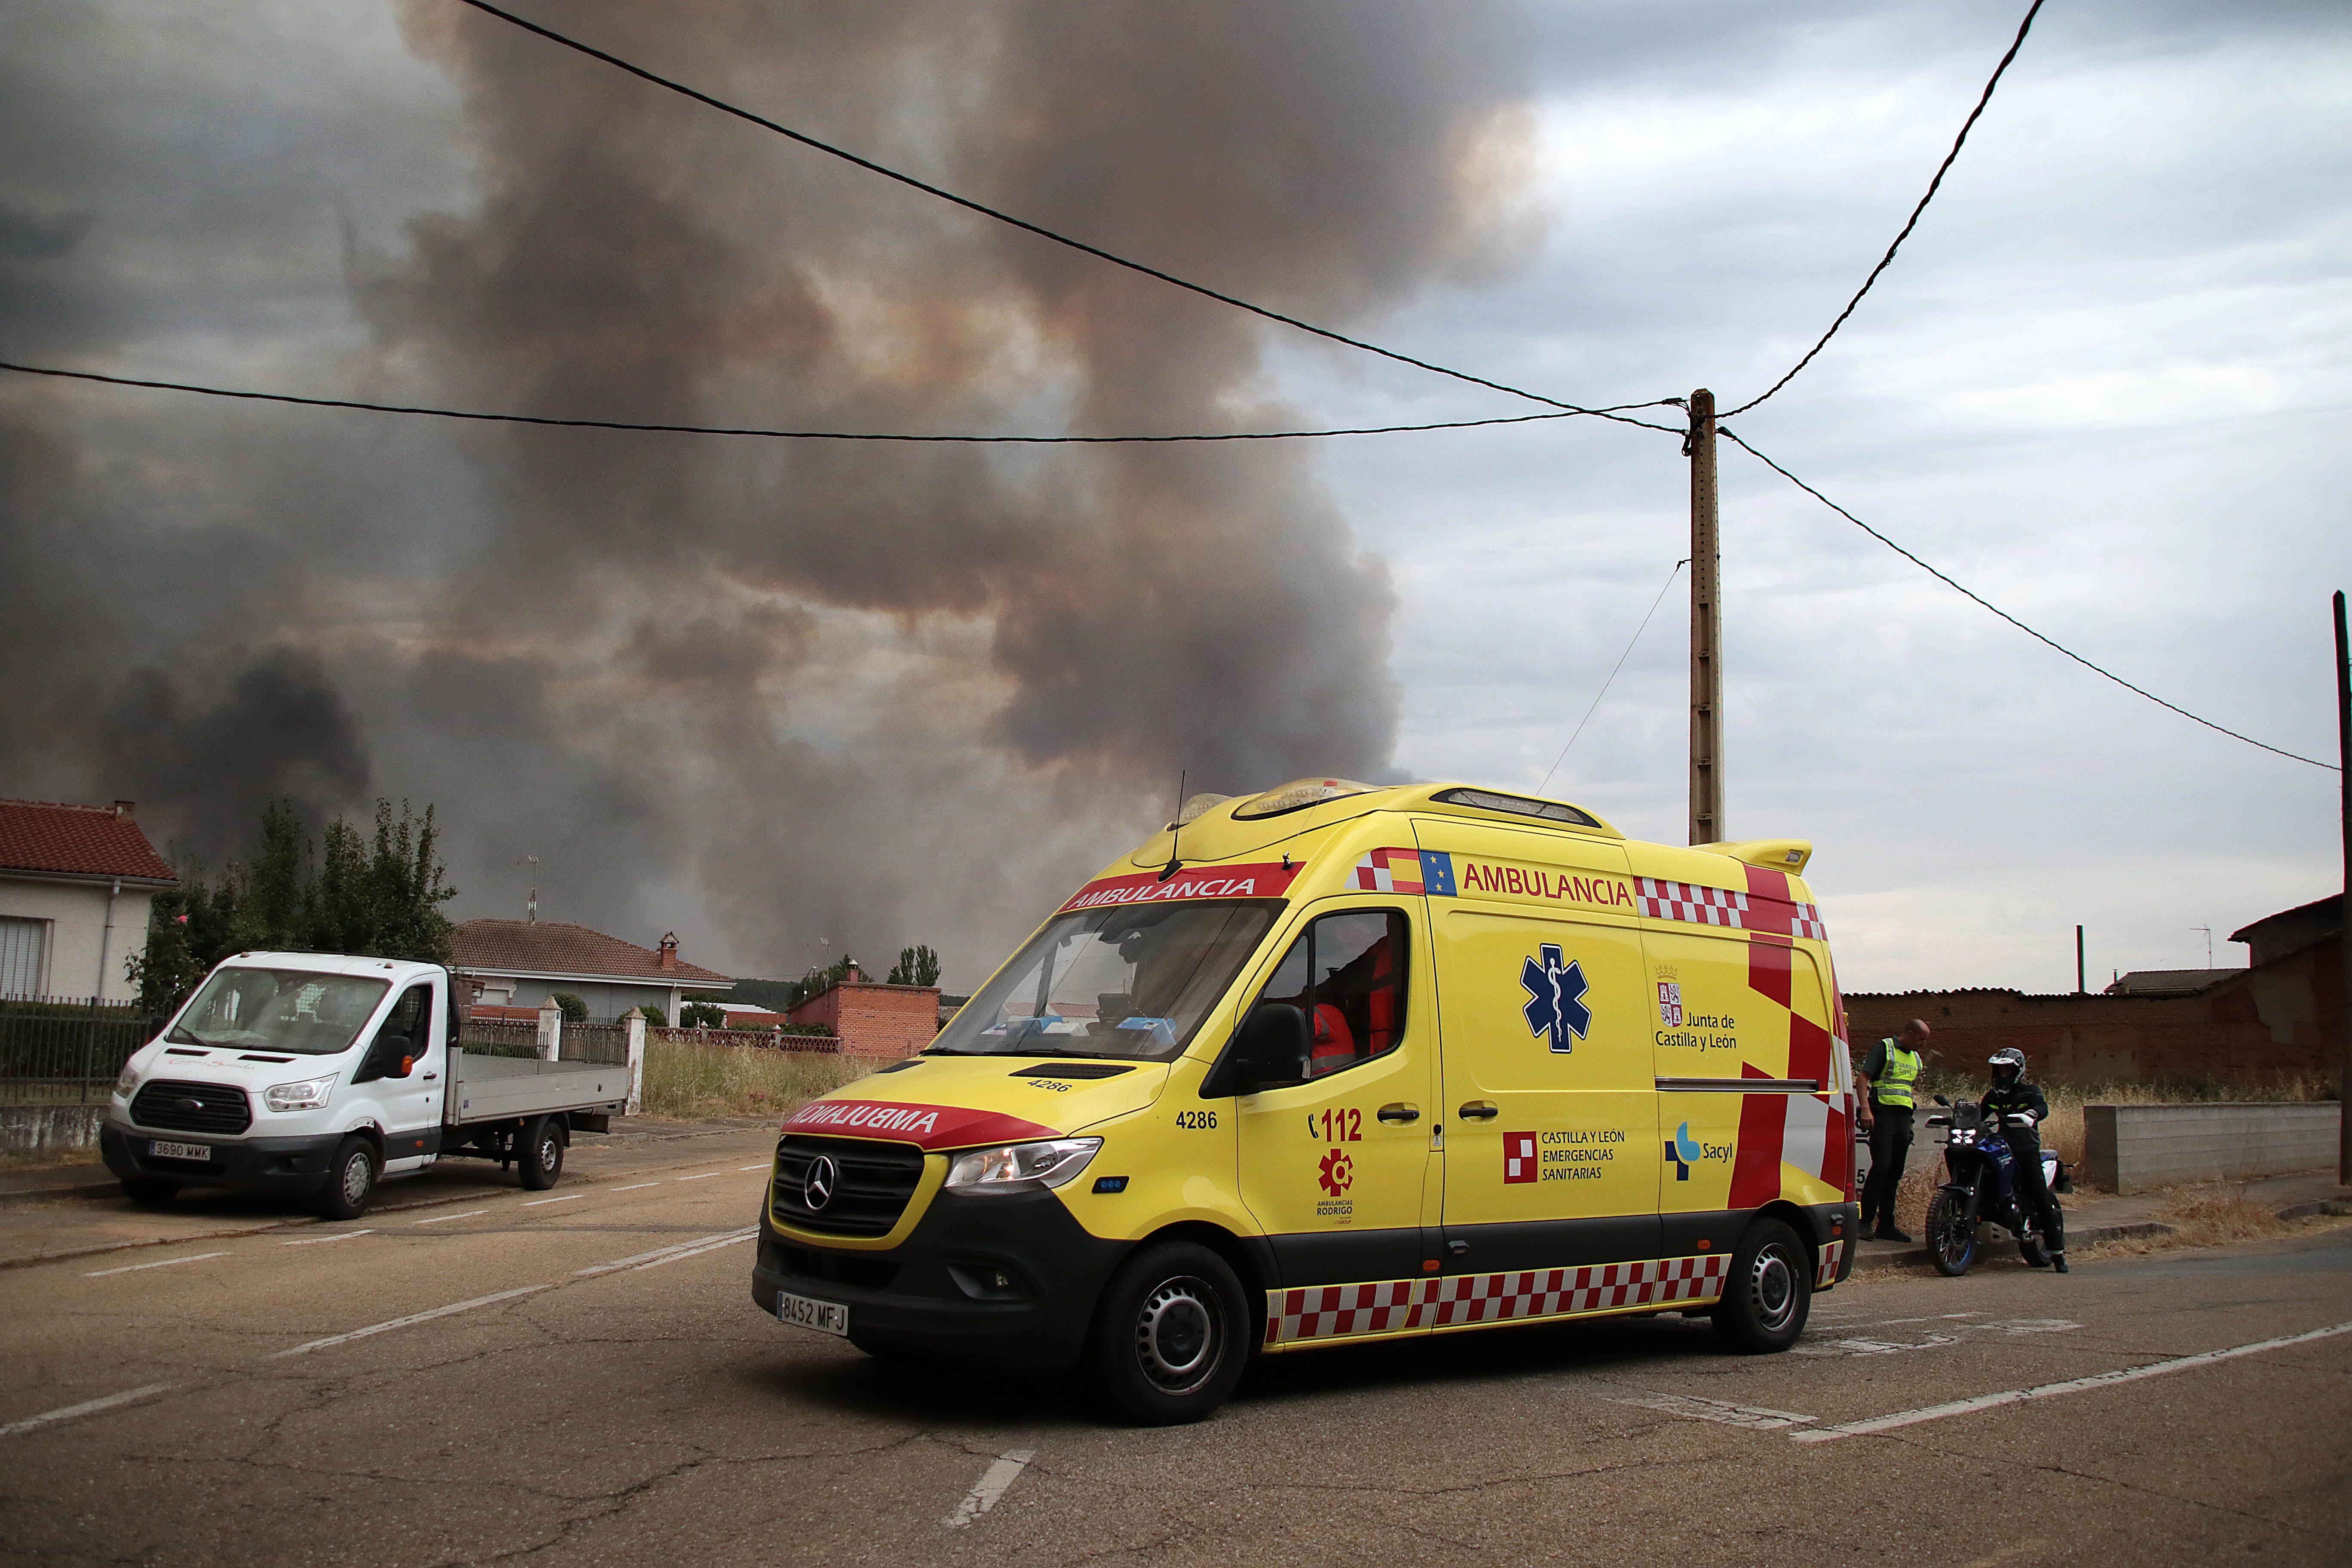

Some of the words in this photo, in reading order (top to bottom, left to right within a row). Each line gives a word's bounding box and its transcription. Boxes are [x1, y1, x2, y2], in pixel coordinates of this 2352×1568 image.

[1070, 878, 1256, 909] AMBULANCIA
[1464, 863, 1633, 907] AMBULANCIA
[1687, 1012, 1718, 1028] Junta
[1721, 1014, 1734, 1029] de
[1655, 1031, 1697, 1047] Castilla
[1700, 1036, 1706, 1052] y
[1710, 1034, 1736, 1048] León
[1028, 1079, 1073, 1092] 4286
[1176, 1111, 1217, 1129] 4286
[1322, 1108, 1362, 1142] 112
[1542, 1131, 1588, 1144] CASTILLA
[1591, 1132, 1597, 1143] Y
[1599, 1128, 1624, 1142] LEÓN
[157, 1143, 183, 1156] 3690
[187, 1146, 208, 1158] MMK
[1543, 1149, 1614, 1162] EMERGENCIAS
[1703, 1143, 1732, 1162] Sacyl
[1542, 1167, 1602, 1181] SANITARIAS
[1317, 1206, 1352, 1216] RODRIGO
[784, 1297, 813, 1324] 8452
[818, 1305, 844, 1330] MFJ
